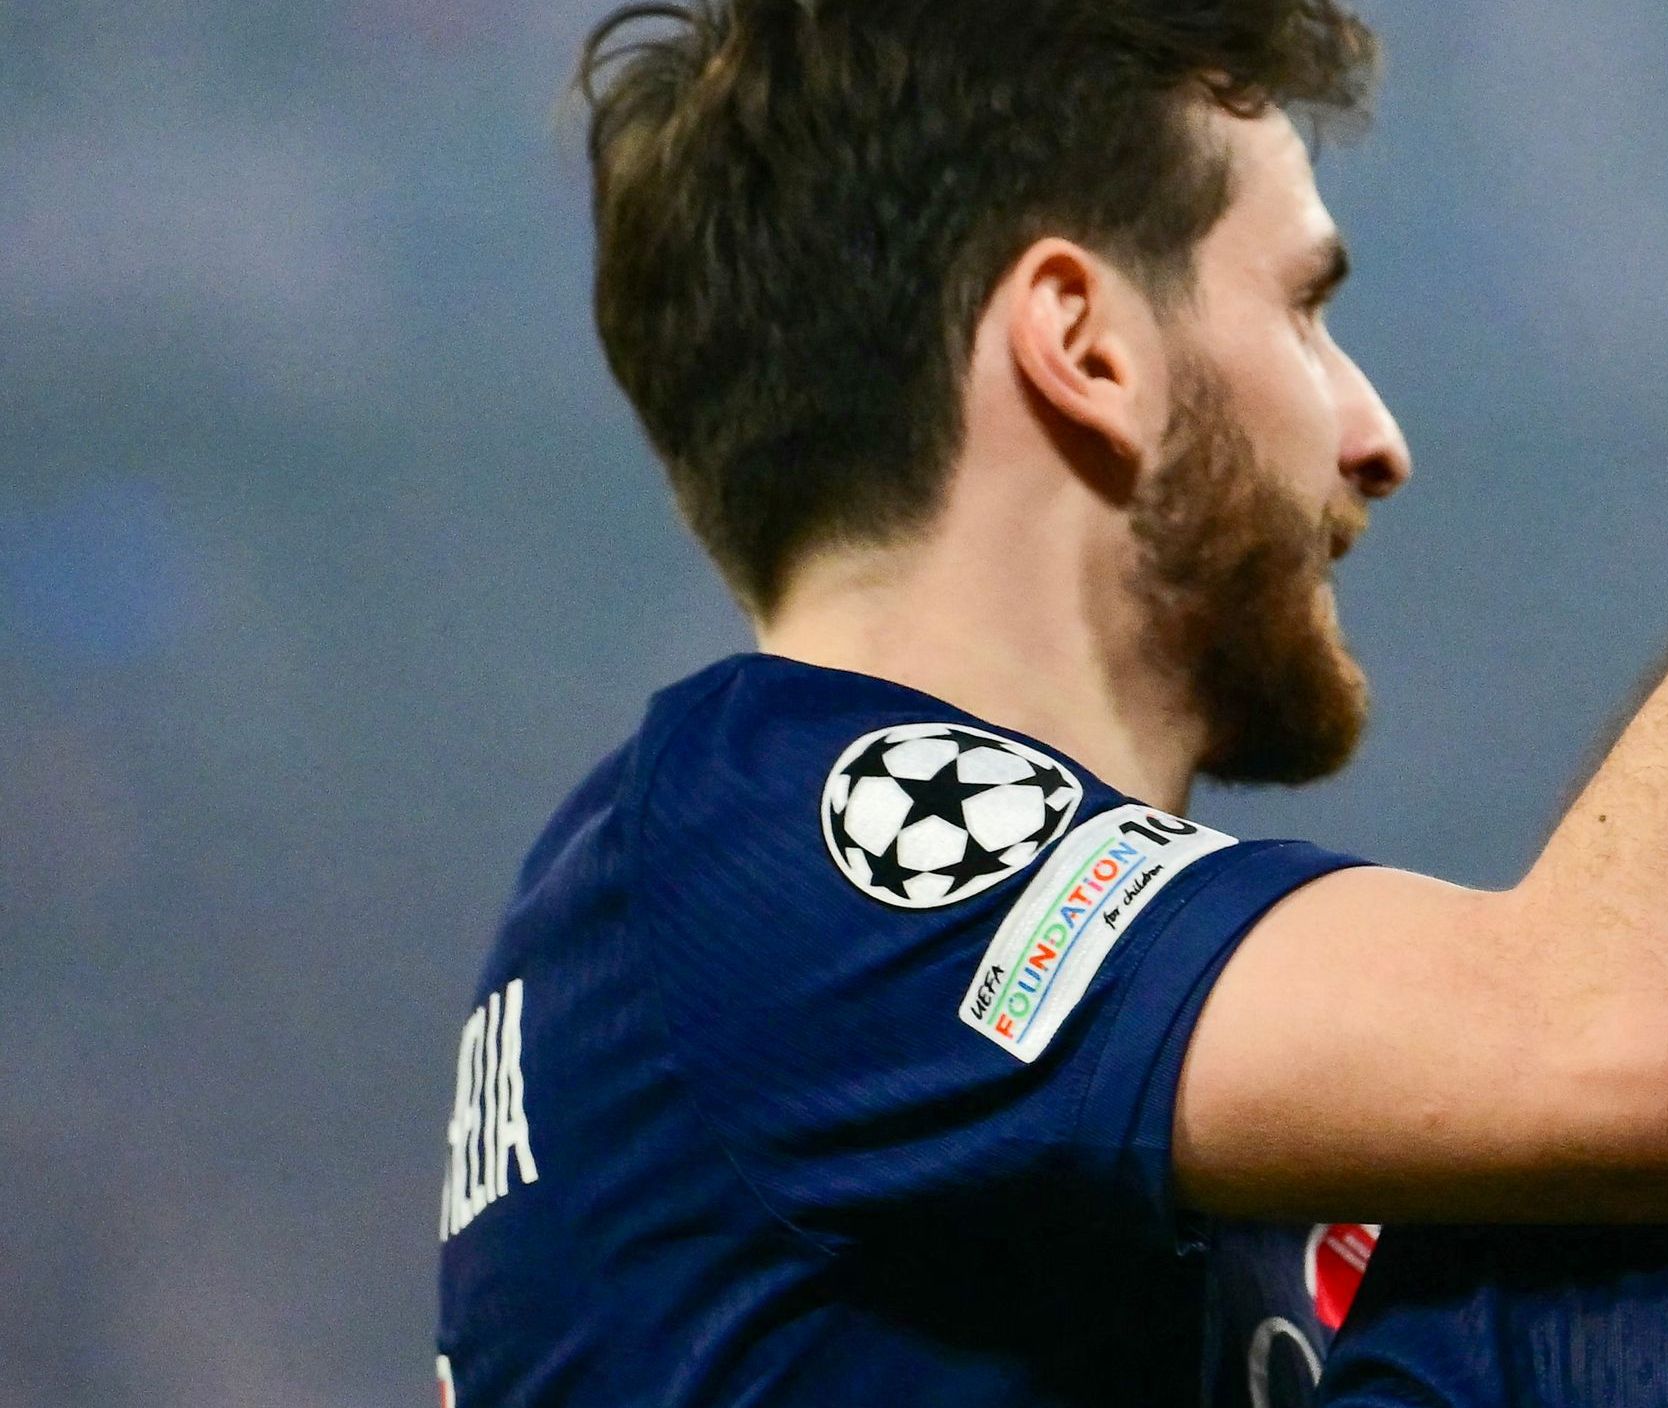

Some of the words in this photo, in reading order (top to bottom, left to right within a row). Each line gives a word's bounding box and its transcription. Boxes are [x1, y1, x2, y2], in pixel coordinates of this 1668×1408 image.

[1102, 910, 1121, 931] for
[1123, 864, 1164, 906] children
[994, 841, 1141, 1039] FOUNDATION
[970, 964, 1005, 1020] UEFA
